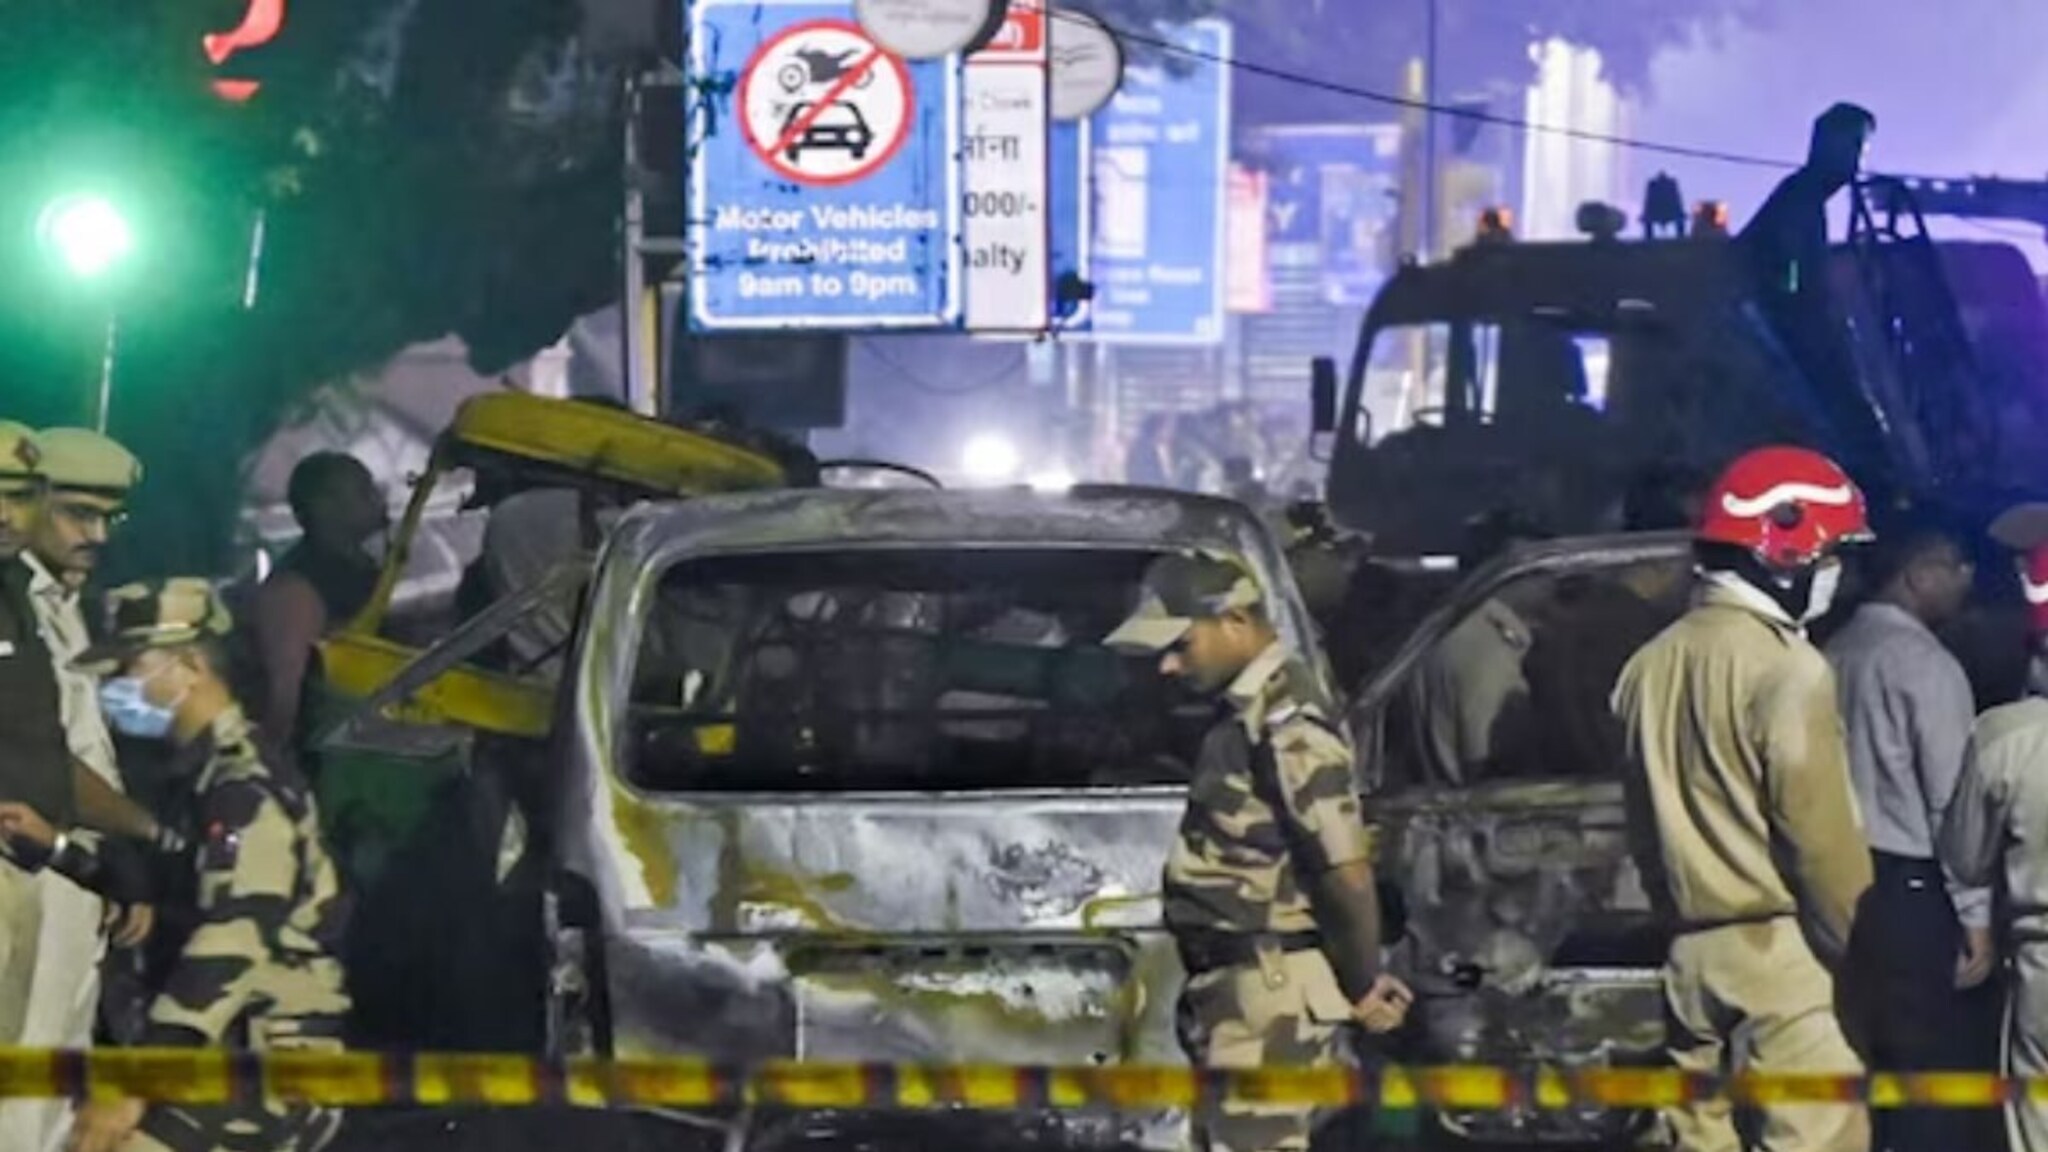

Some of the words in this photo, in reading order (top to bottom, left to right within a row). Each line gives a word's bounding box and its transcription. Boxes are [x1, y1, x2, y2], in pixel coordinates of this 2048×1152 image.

[715, 205, 803, 231] Motor
[811, 205, 938, 230] Vehicles
[748, 237, 906, 262] Prohibited
[738, 273, 801, 298] 9am
[811, 274, 843, 296] to
[850, 272, 917, 300] 9pm
